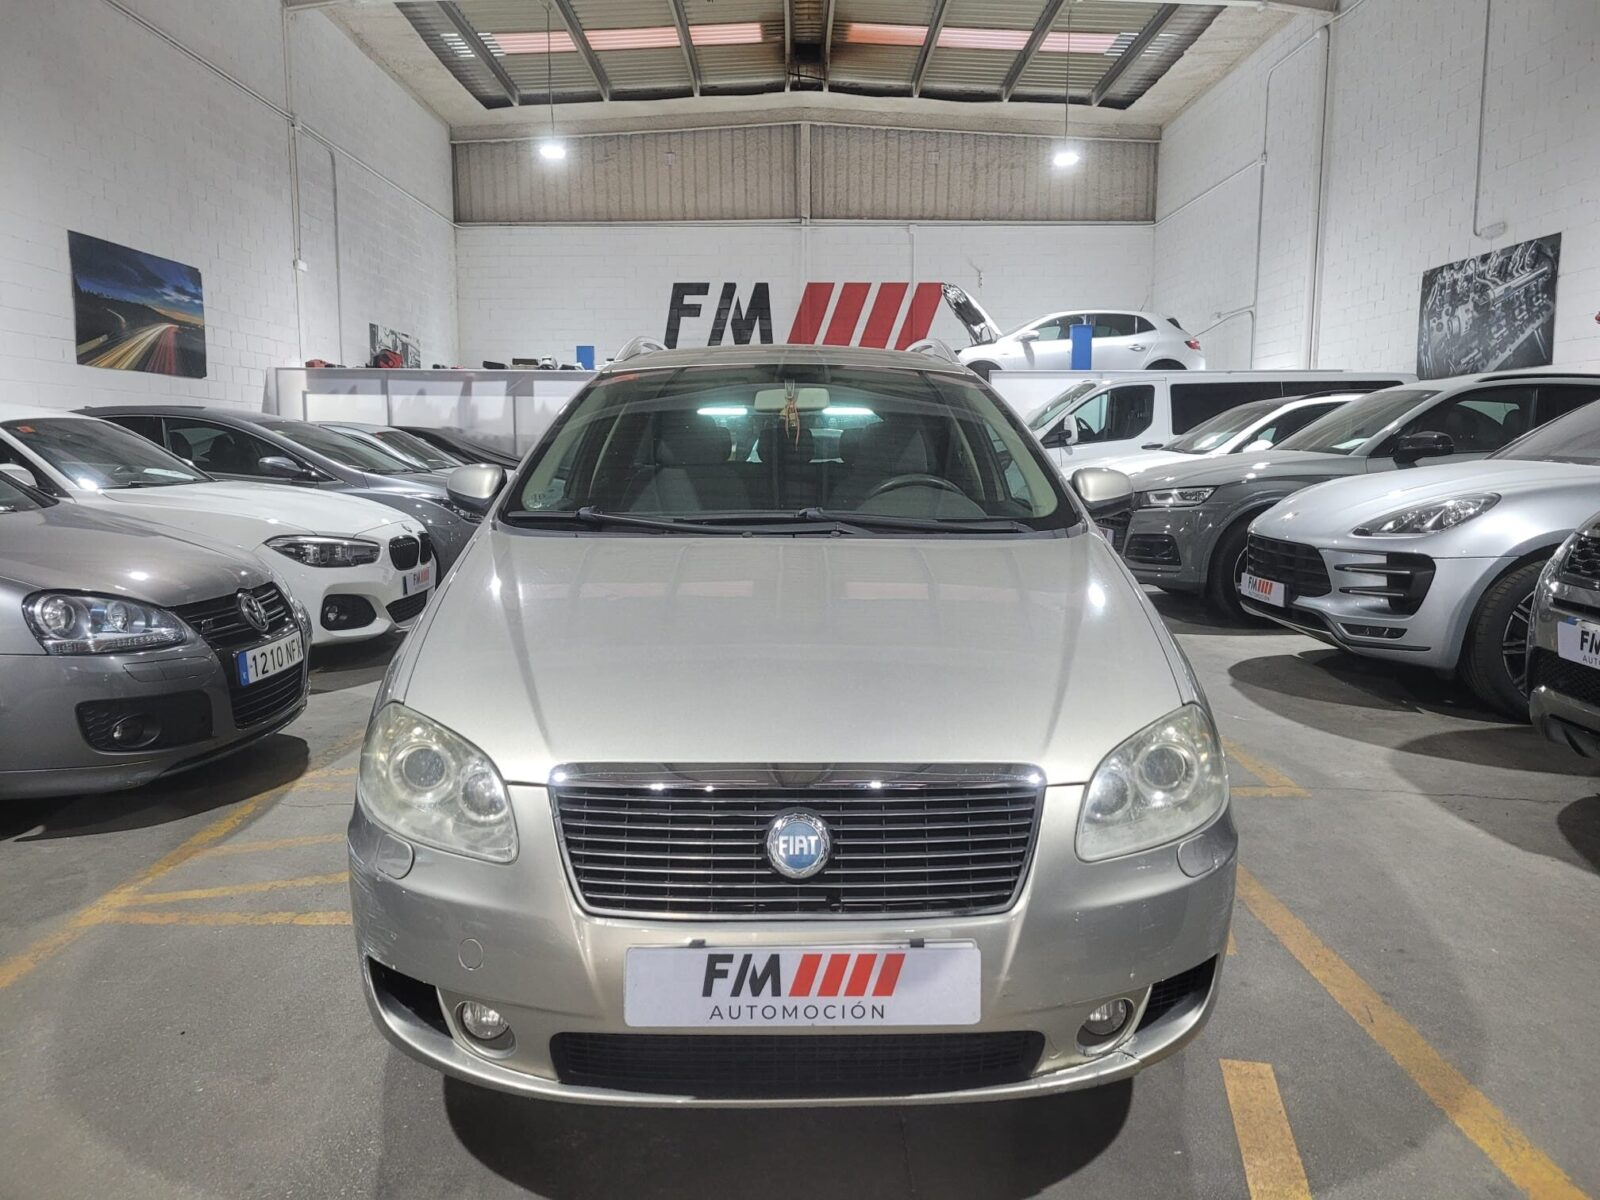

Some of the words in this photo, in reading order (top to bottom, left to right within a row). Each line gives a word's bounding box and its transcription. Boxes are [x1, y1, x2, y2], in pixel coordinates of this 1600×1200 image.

[664, 282, 773, 349] FM
[252, 646, 284, 677] 1210
[779, 836, 818, 857] FIAT
[702, 953, 781, 998] FM
[709, 1001, 885, 1020] AUTOMOCIÓN
